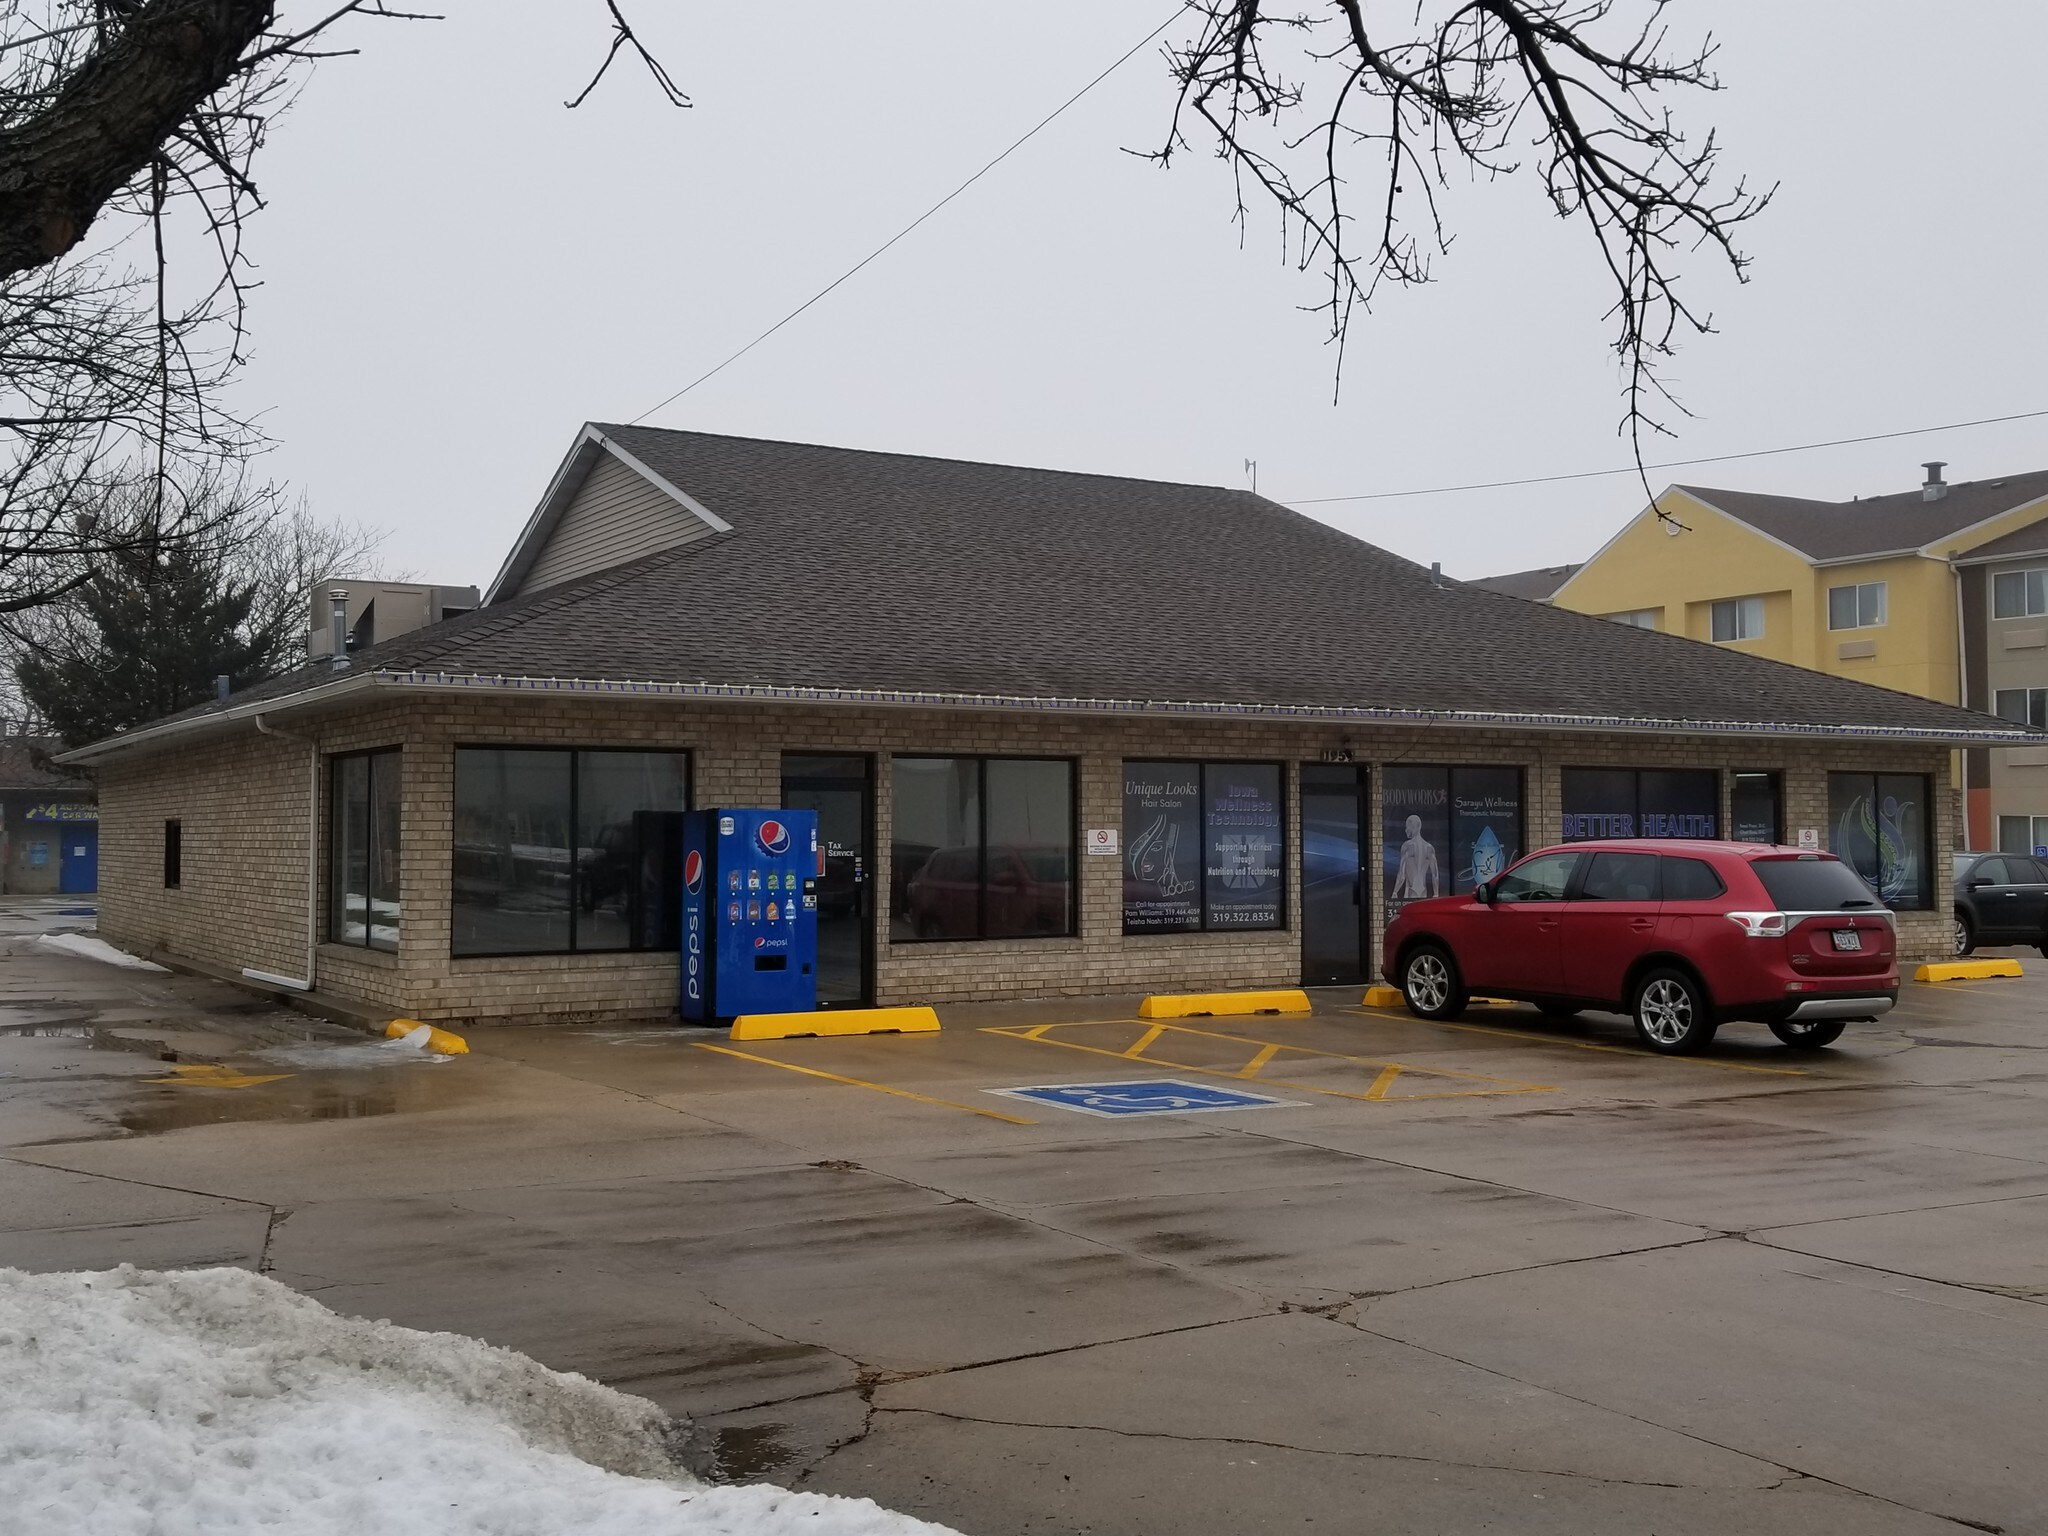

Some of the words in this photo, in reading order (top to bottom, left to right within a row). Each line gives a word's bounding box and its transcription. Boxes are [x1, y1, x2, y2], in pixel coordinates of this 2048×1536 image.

[1125, 780, 1164, 799] Unique
[1165, 781, 1198, 796] Looks
[1228, 784, 1259, 798] Iowa
[1141, 799, 1158, 808] Hair
[1159, 798, 1182, 808] Salon
[1382, 789, 1439, 806] BODYWORKS
[1454, 797, 1483, 810] Sarayu
[1484, 796, 1519, 809] Wellness
[1215, 798, 1273, 812] Wellness
[1207, 812, 1280, 828] Technology
[1561, 813, 1635, 838] BETTER
[1641, 813, 1715, 838] HEALTH
[1215, 842, 1248, 853] Supporting
[1248, 843, 1272, 851] Wellness
[1232, 856, 1255, 865] through
[1207, 866, 1234, 876] Nutrition
[1235, 866, 1246, 876] and
[1247, 866, 1280, 878] Technology
[1125, 909, 1139, 917] Pam
[1232, 903, 1262, 911] appointment
[1263, 903, 1278, 911] today
[1212, 912, 1275, 922] 319.322.8334
[766, 938, 788, 948] pepsi
[687, 906, 700, 999] pepsi
